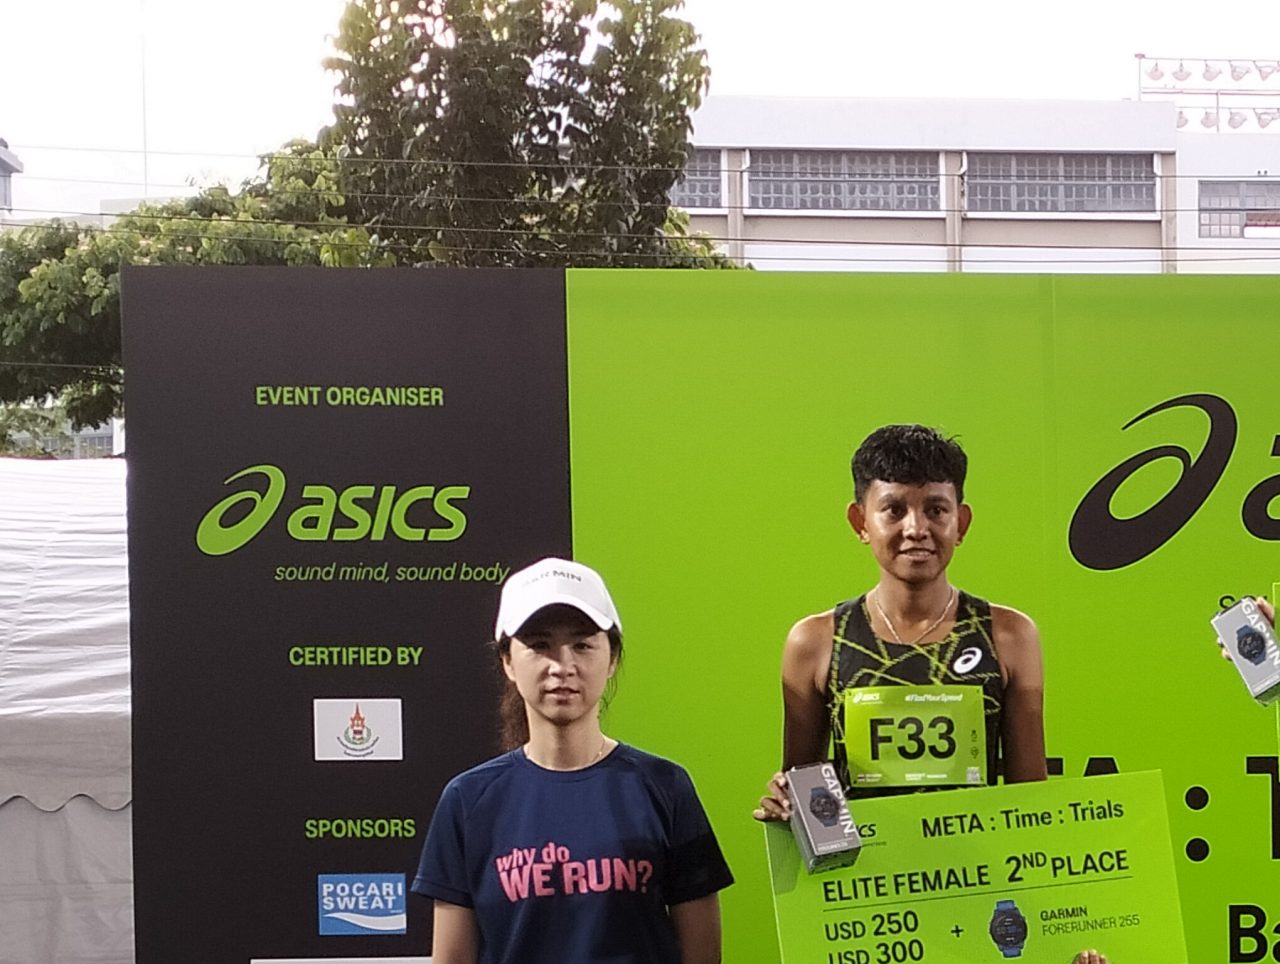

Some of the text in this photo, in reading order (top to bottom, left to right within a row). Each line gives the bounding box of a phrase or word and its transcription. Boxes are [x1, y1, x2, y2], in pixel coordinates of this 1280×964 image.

[255, 387, 444, 406] EVENT ORGANISER
[274, 562, 511, 585] sound mind, sound body
[289, 647, 423, 666] CERTIFIED BY
[869, 716, 957, 761] F33
[305, 819, 416, 839] SPONSORS
[922, 813, 985, 839] META
[1000, 808, 1052, 830] Time
[1068, 800, 1125, 822] Trials
[496, 841, 570, 872] why do
[500, 858, 653, 903] WE RUN?
[822, 875, 888, 902] ELITE
[893, 865, 991, 895] FEMALE
[1051, 849, 1129, 878] PLACE
[322, 881, 404, 898] POCARI
[322, 896, 395, 911] SWEAT
[1040, 907, 1088, 921] GARMIN
[824, 910, 919, 942] USD 250
[1042, 914, 1140, 936] FORERUNNER 255
